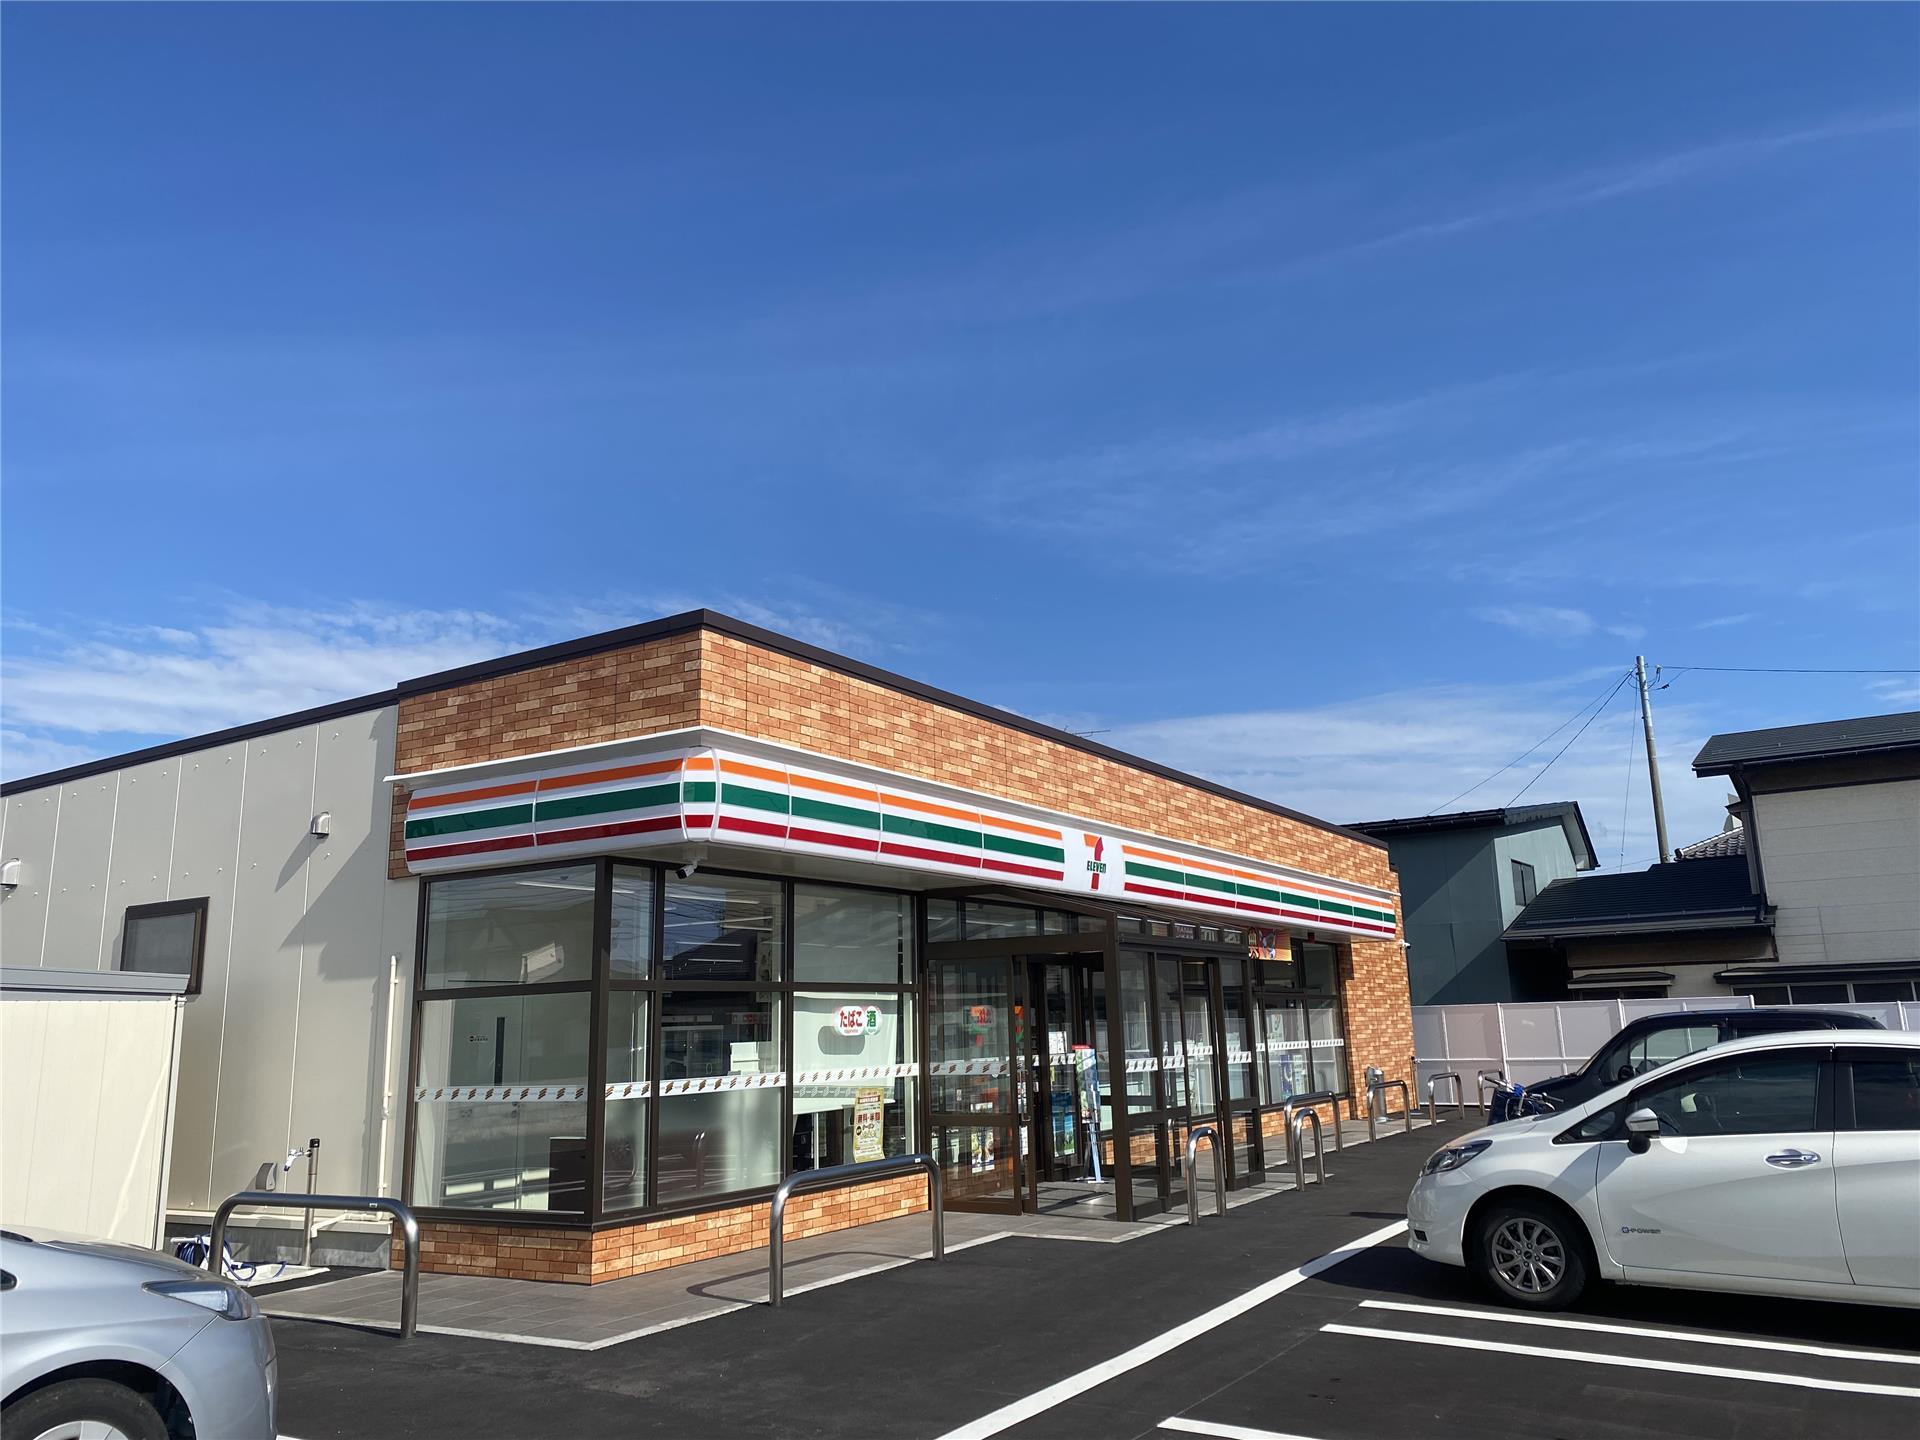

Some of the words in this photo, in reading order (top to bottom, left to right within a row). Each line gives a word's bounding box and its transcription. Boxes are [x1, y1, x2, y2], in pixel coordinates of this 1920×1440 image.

[1083, 834, 1104, 890] 7
[839, 1010, 863, 1028] たばこ
[866, 1010, 877, 1028] 酒
